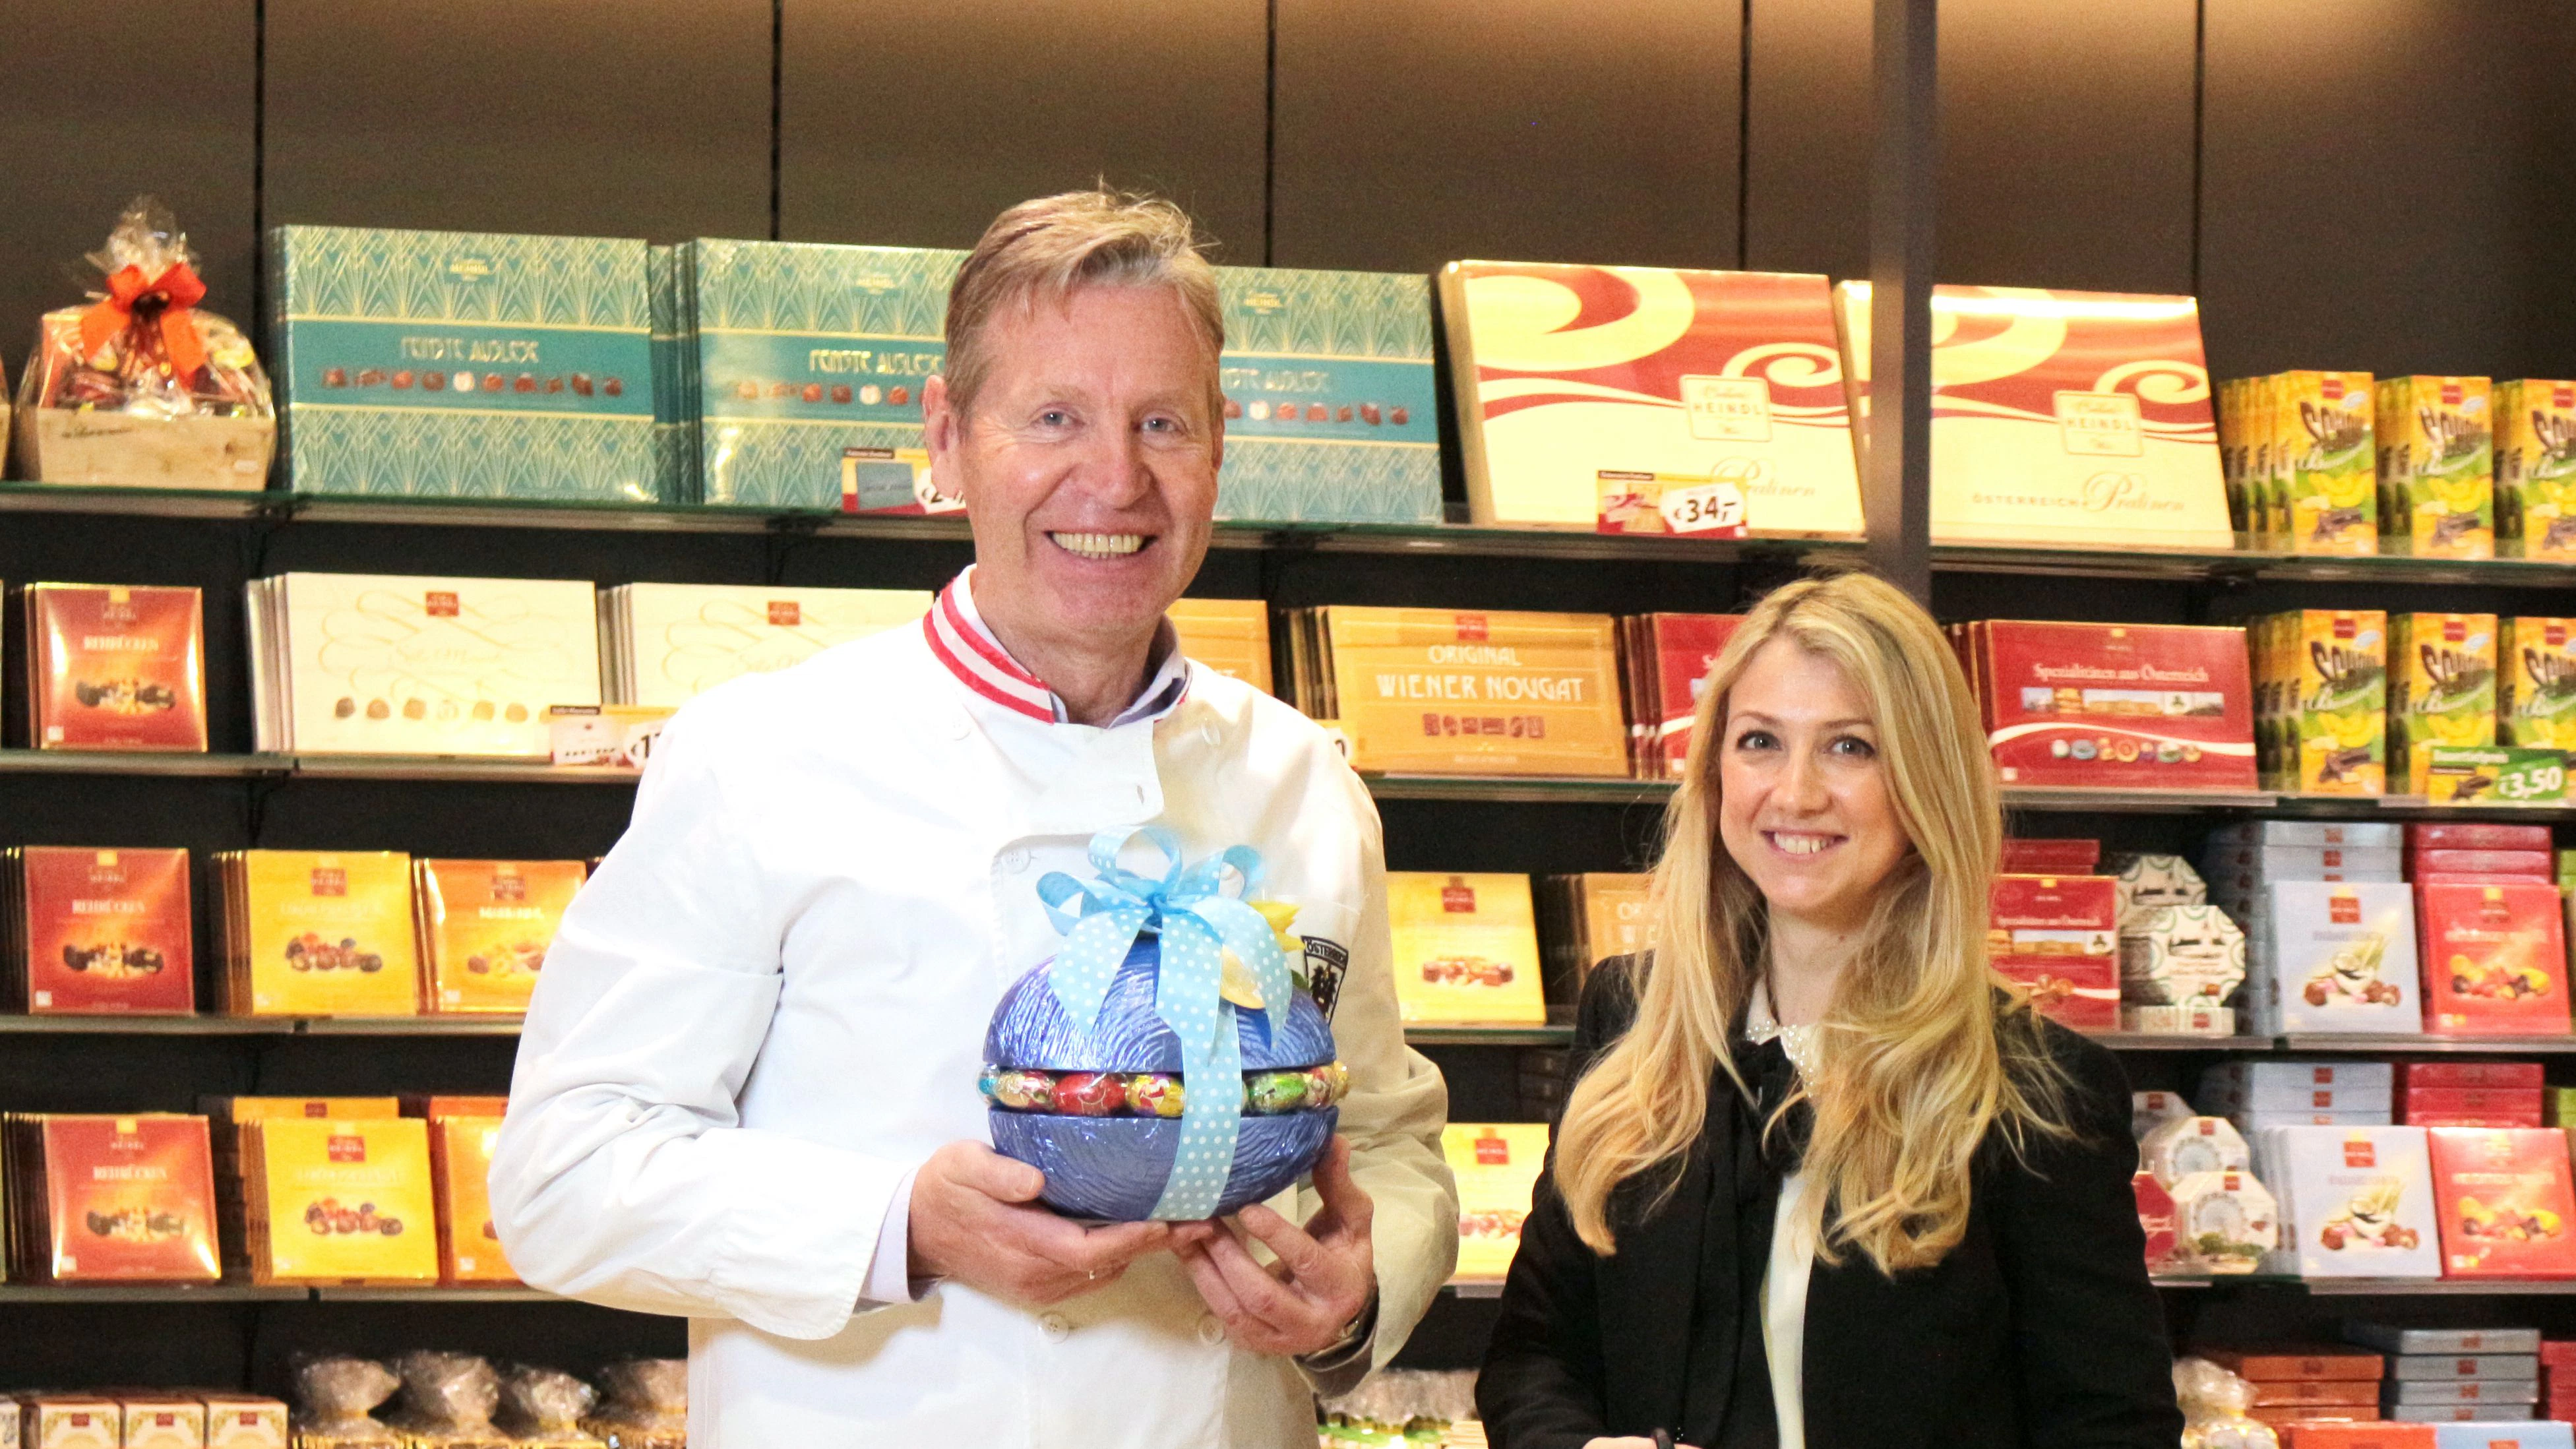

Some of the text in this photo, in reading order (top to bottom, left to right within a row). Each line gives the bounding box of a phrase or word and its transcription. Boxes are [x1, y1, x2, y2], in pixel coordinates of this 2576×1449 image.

[1427, 644, 1522, 667] ORIGINAL
[1376, 674, 1583, 701] WIENER NOUGAT
